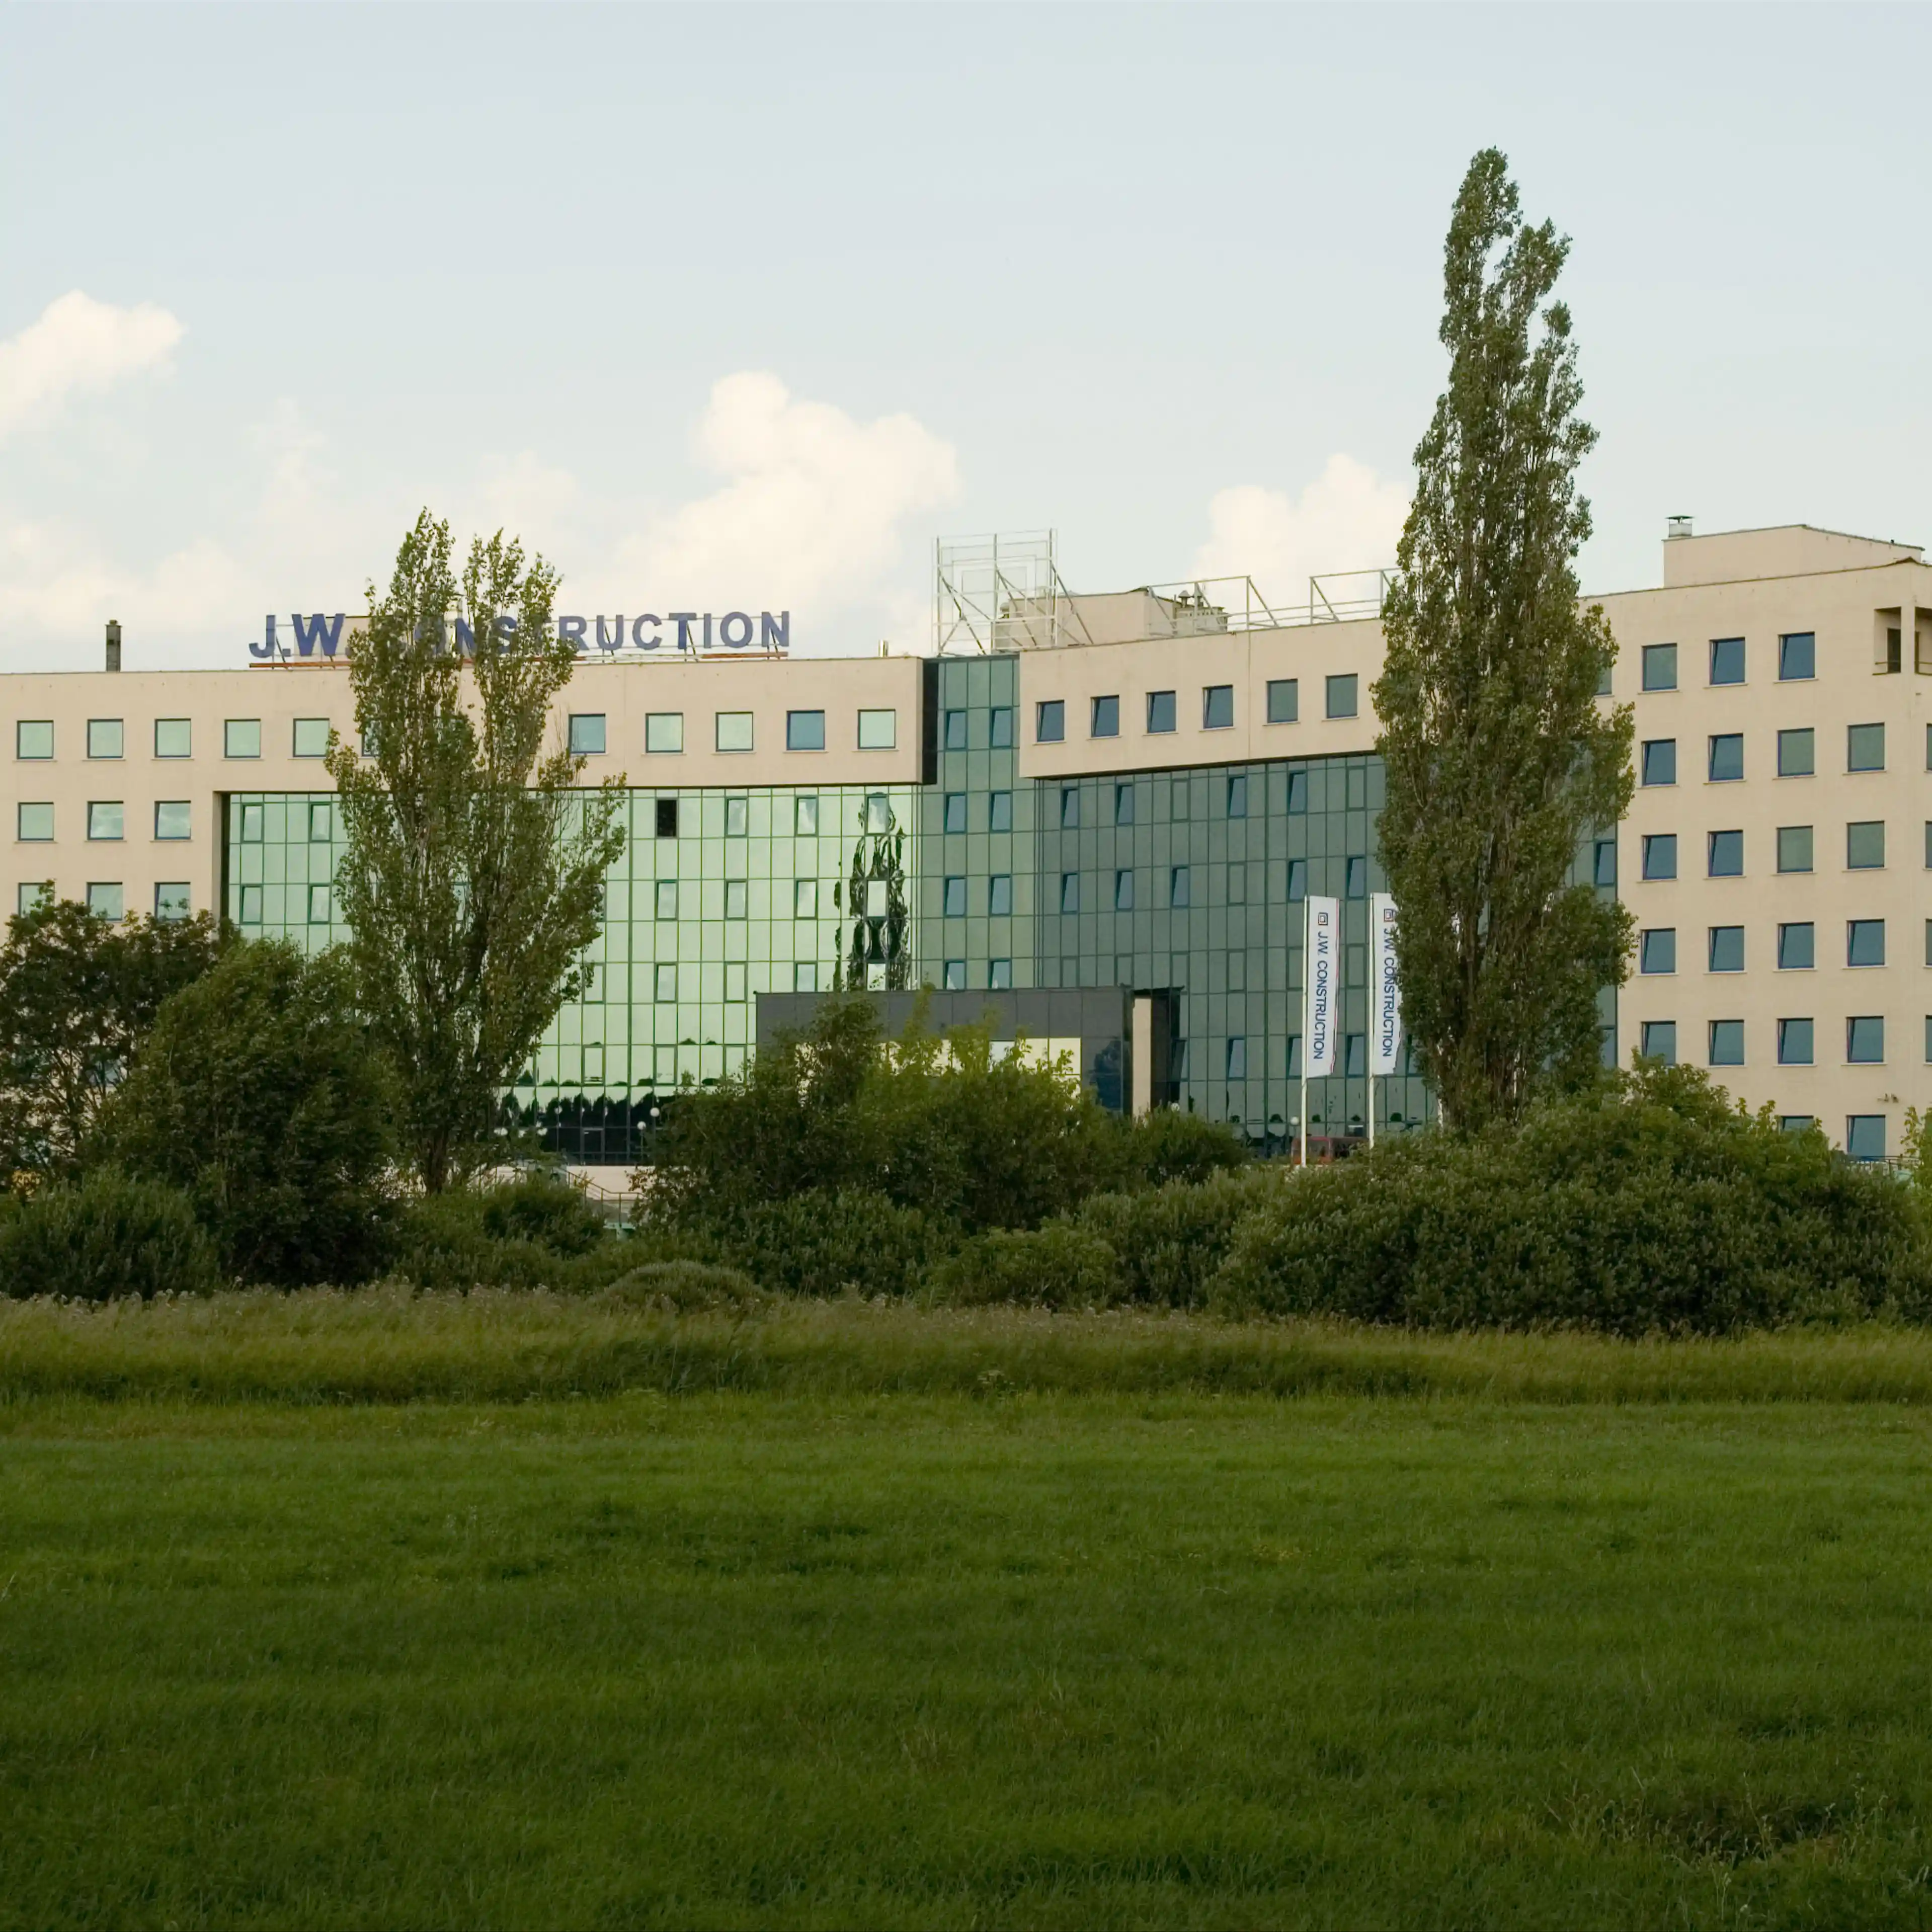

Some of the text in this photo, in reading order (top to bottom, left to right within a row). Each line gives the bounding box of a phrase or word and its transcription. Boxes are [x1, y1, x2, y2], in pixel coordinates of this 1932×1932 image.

[1314, 931, 1328, 1060] J.W. CONSTRUCTION
[1383, 957, 1395, 1057] CONSTRUCTION
